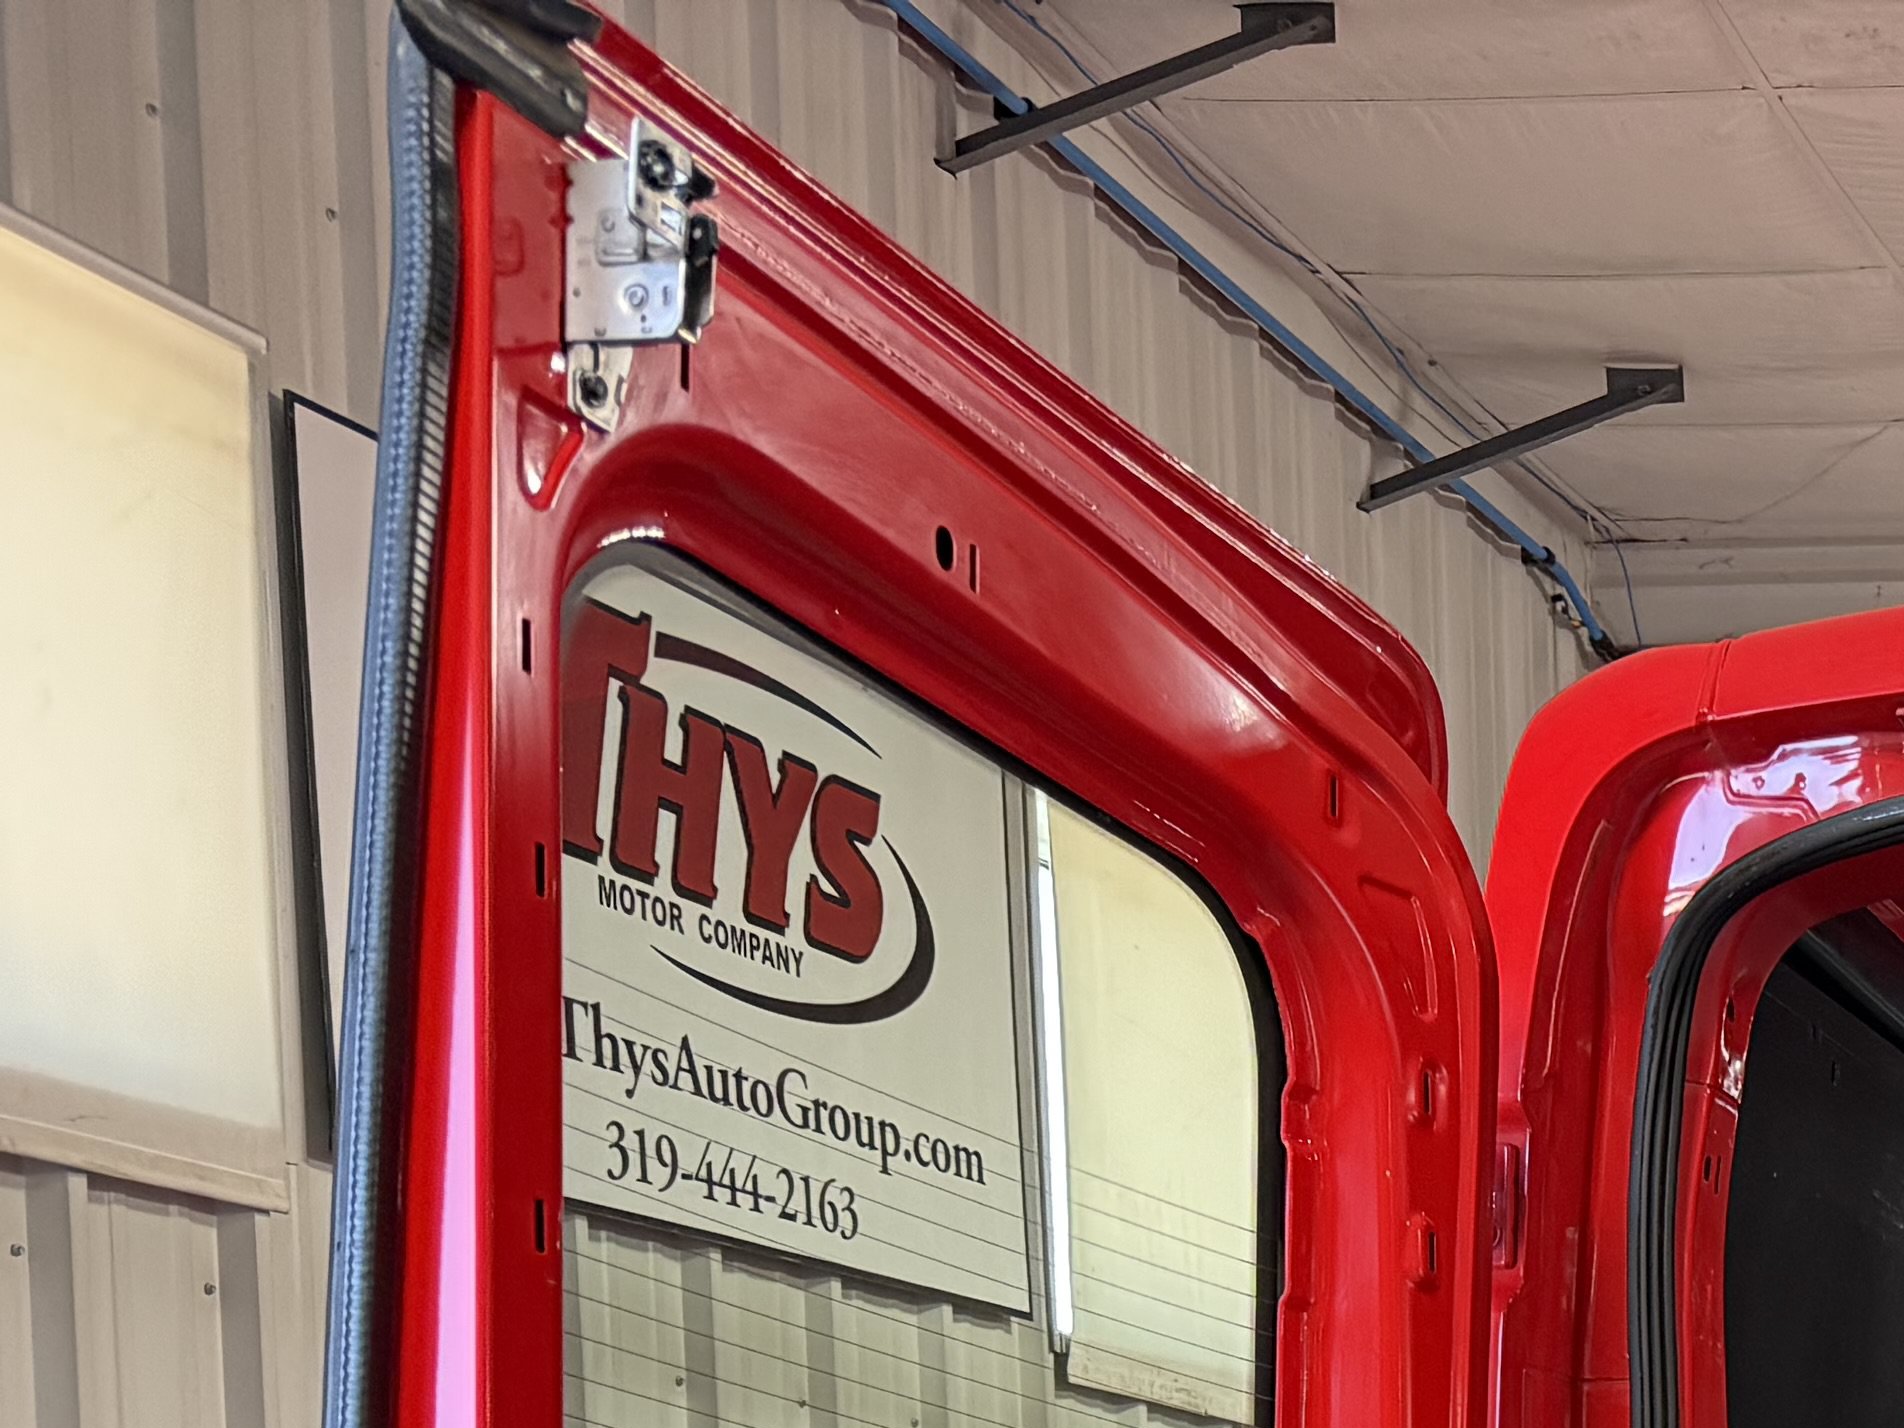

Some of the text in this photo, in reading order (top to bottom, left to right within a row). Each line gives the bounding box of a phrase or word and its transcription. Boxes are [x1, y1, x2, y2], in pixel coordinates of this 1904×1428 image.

[561, 597, 884, 964] THYS
[597, 874, 805, 979] MOTOR COMPANY
[561, 995, 987, 1186] ThysAutoGroup.com
[605, 1119, 860, 1242] 319-444-2163
